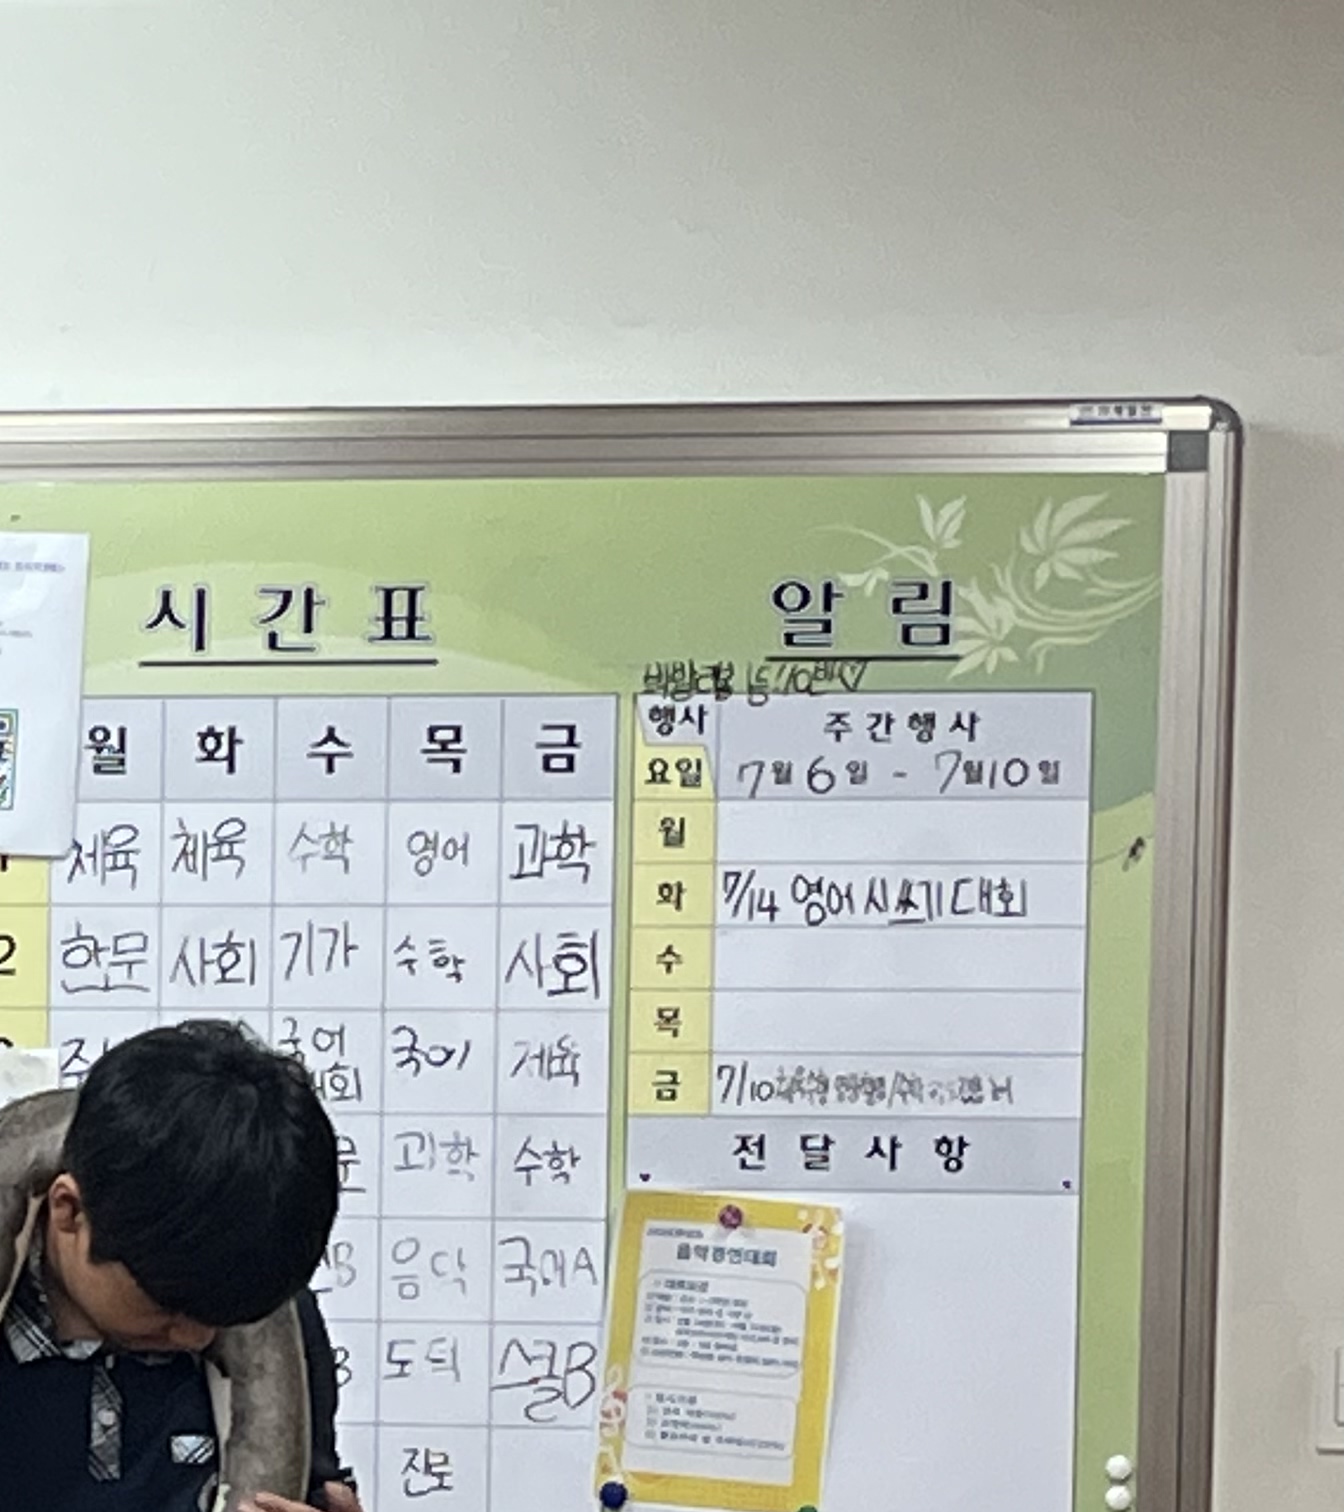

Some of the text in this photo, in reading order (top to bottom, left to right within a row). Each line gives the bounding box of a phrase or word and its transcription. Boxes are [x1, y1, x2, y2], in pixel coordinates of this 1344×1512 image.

[647, 703, 709, 737] 행사
[83, 724, 128, 776] 월
[194, 724, 244, 775] 화
[305, 724, 355, 775] 수
[420, 724, 469, 775] 목
[534, 723, 583, 774] 금
[643, 757, 703, 789] 요일
[169, 815, 247, 883] 체육
[288, 819, 356, 876] 수학
[406, 829, 471, 878] 영어
[508, 818, 598, 885] 과학
[656, 816, 687, 849] 월
[655, 880, 687, 912] 화
[722, 868, 780, 923] 7/14
[169, 928, 257, 989] 사회
[278, 919, 360, 983] 기가
[393, 933, 467, 985] 수학
[504, 928, 602, 1000] 사회
[655, 943, 685, 976] 수
[654, 1006, 683, 1038] 목
[651, 1070, 682, 1102] 금
[512, 1134, 581, 1187] 수학
